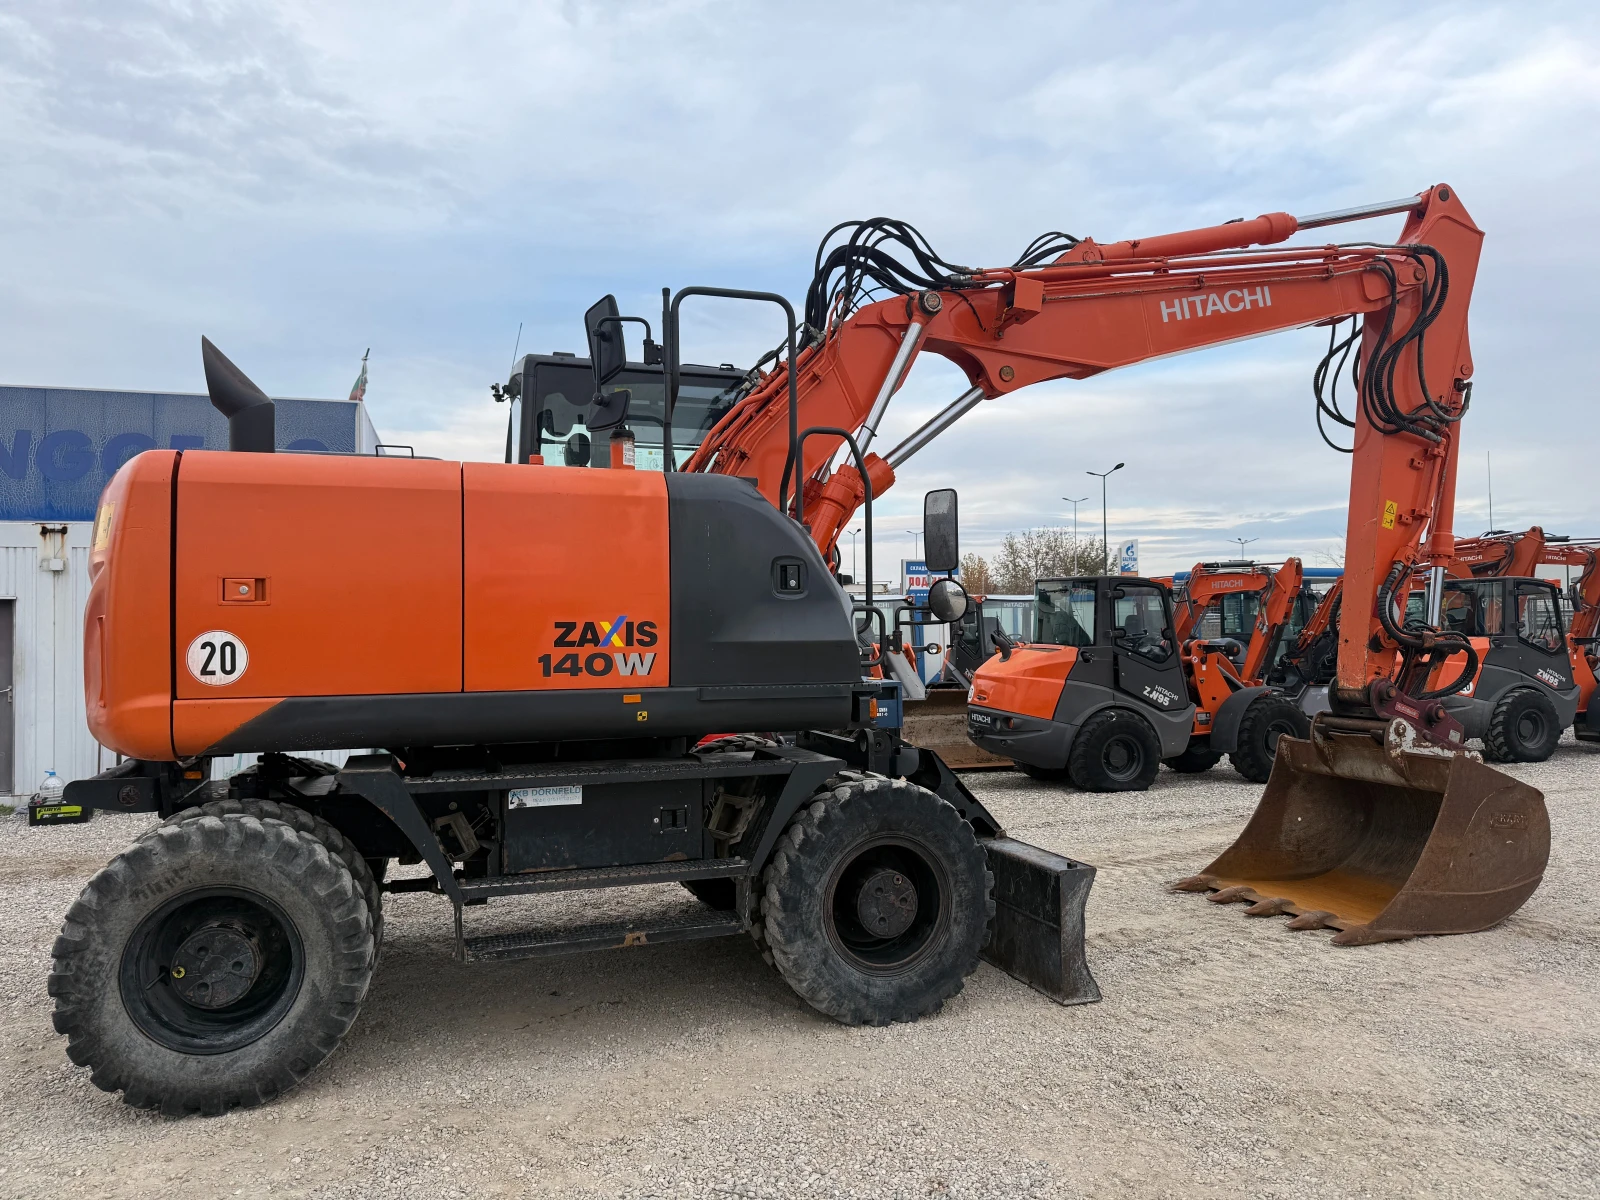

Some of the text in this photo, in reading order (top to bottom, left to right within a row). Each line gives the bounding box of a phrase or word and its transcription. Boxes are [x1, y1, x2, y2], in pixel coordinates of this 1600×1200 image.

[1160, 286, 1272, 323] HITACHI
[1211, 579, 1243, 589] HITACHI
[553, 615, 658, 648] ZAXIS
[200, 641, 237, 676] 20
[538, 652, 657, 678] 140W
[1536, 668, 1559, 686] ZW95
[1546, 667, 1567, 682] HITACHI
[1154, 684, 1179, 701] HITACHI
[971, 713, 991, 724] HITACHI
